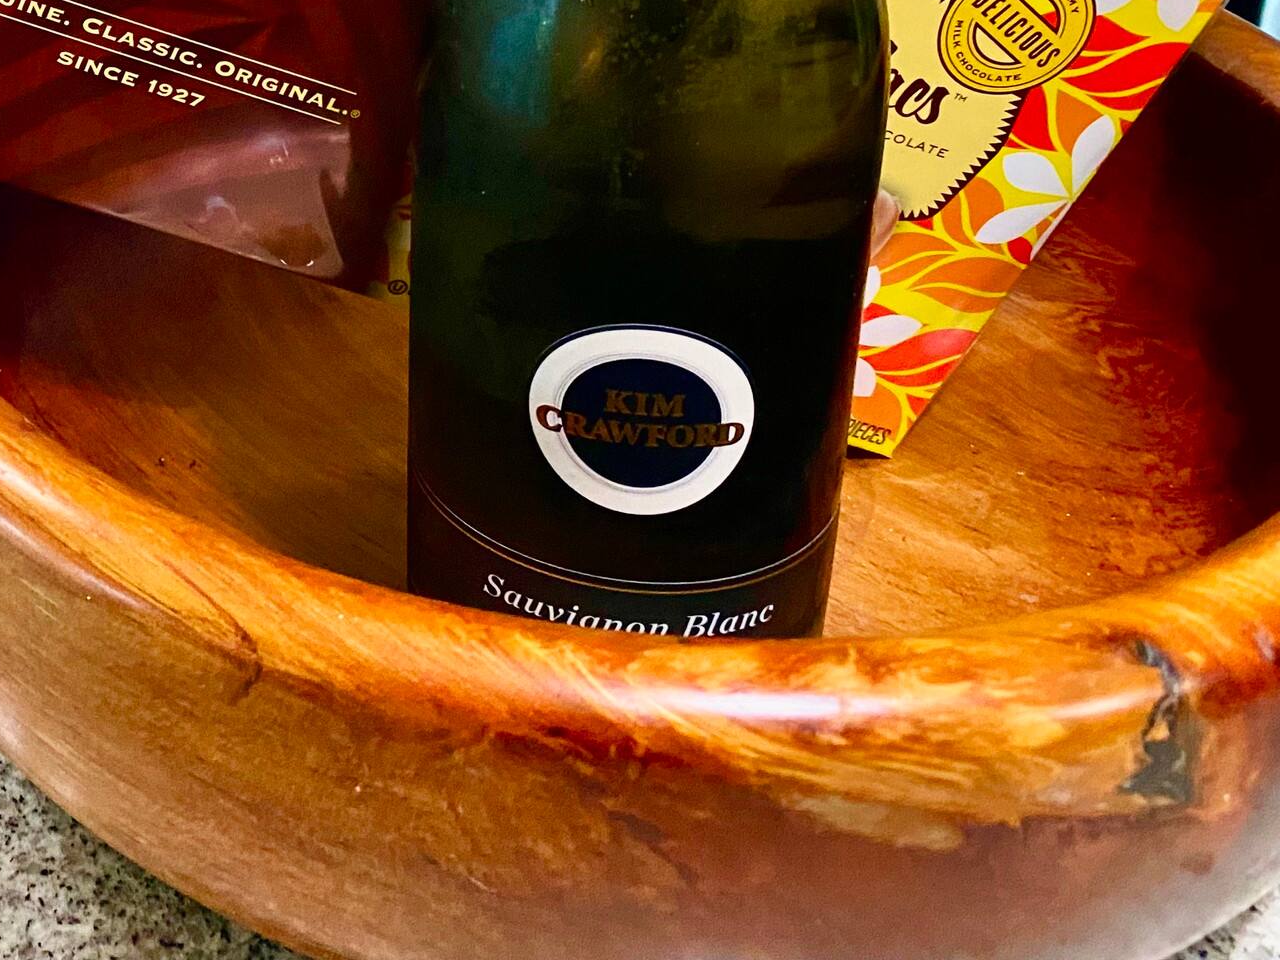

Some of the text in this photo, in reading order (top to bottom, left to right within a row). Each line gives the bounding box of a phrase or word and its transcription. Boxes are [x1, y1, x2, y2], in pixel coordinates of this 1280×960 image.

[82, 17, 203, 70] CLASSIC.
[214, 60, 349, 116] ORIGINAL.
[952, 19, 1023, 82] MILK CHOCOLATE
[56, 51, 206, 109] SINCE 1927
[883, 129, 950, 159] COLATE
[604, 388, 686, 418] KIM
[535, 404, 745, 449] CRAWFORD
[682, 603, 775, 638] Blanc
